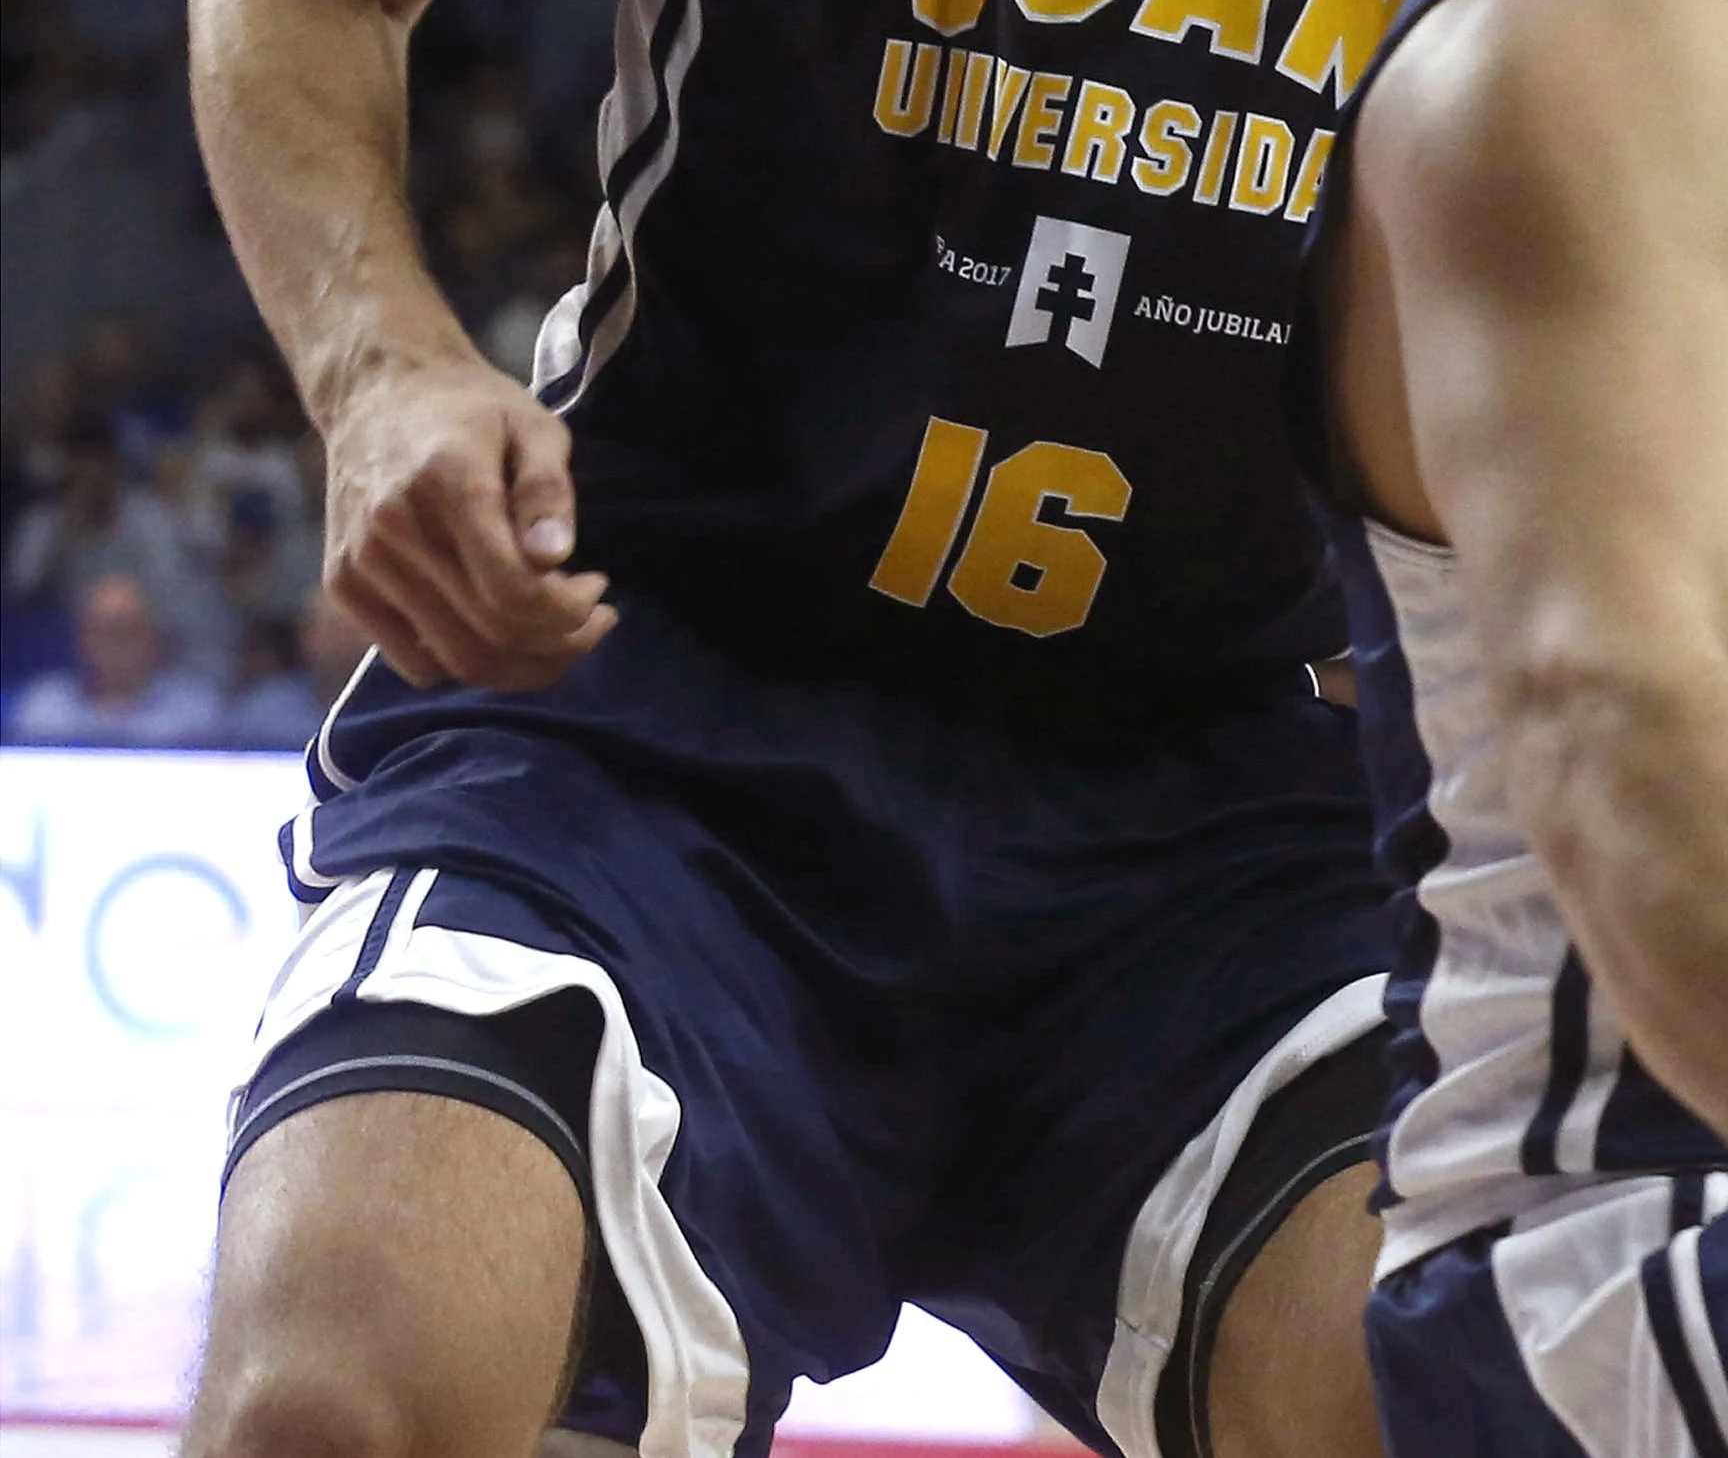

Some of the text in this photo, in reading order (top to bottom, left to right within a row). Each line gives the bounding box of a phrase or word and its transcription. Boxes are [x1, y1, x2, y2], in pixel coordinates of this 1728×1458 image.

[958, 256, 1012, 286] 2017
[1134, 294, 1193, 327] AÑO
[868, 415, 1133, 638] 16
